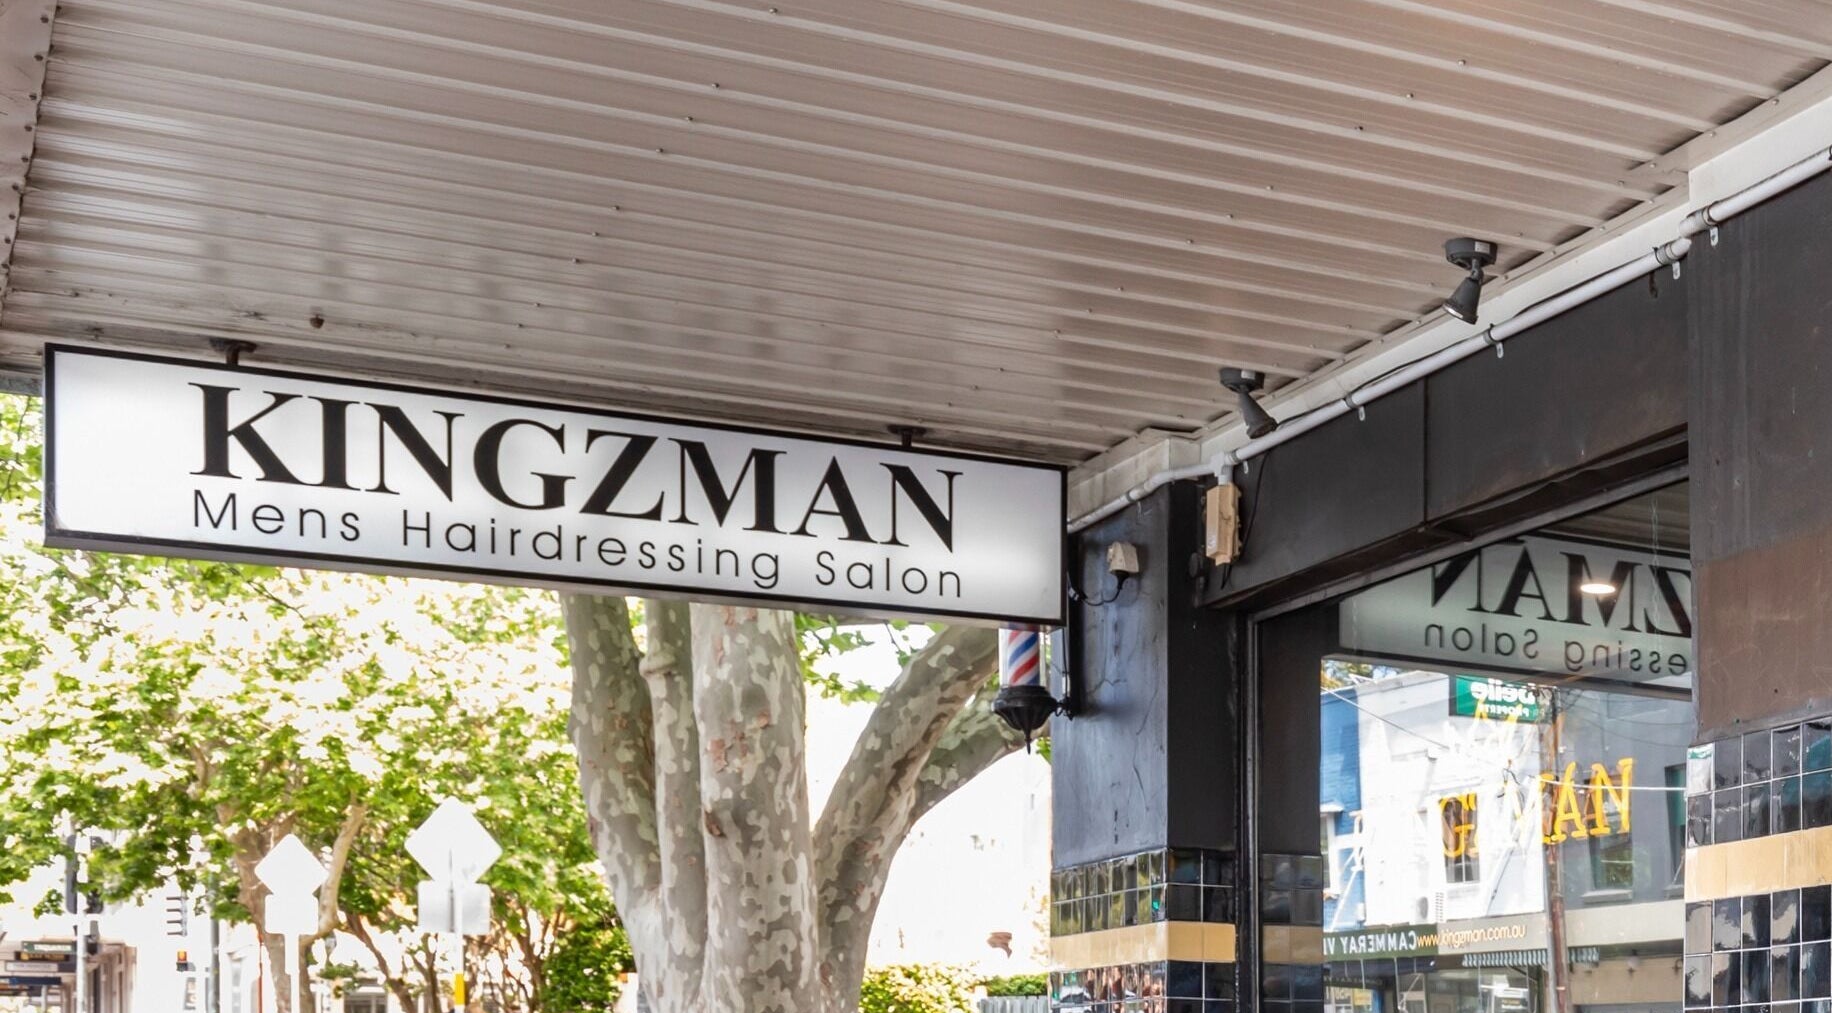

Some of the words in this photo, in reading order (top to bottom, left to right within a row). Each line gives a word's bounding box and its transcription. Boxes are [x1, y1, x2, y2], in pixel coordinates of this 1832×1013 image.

[188, 381, 962, 552] KINGZMAN
[193, 490, 360, 541] Mens
[403, 509, 781, 588] Hairdressing
[815, 548, 962, 598] Salon
